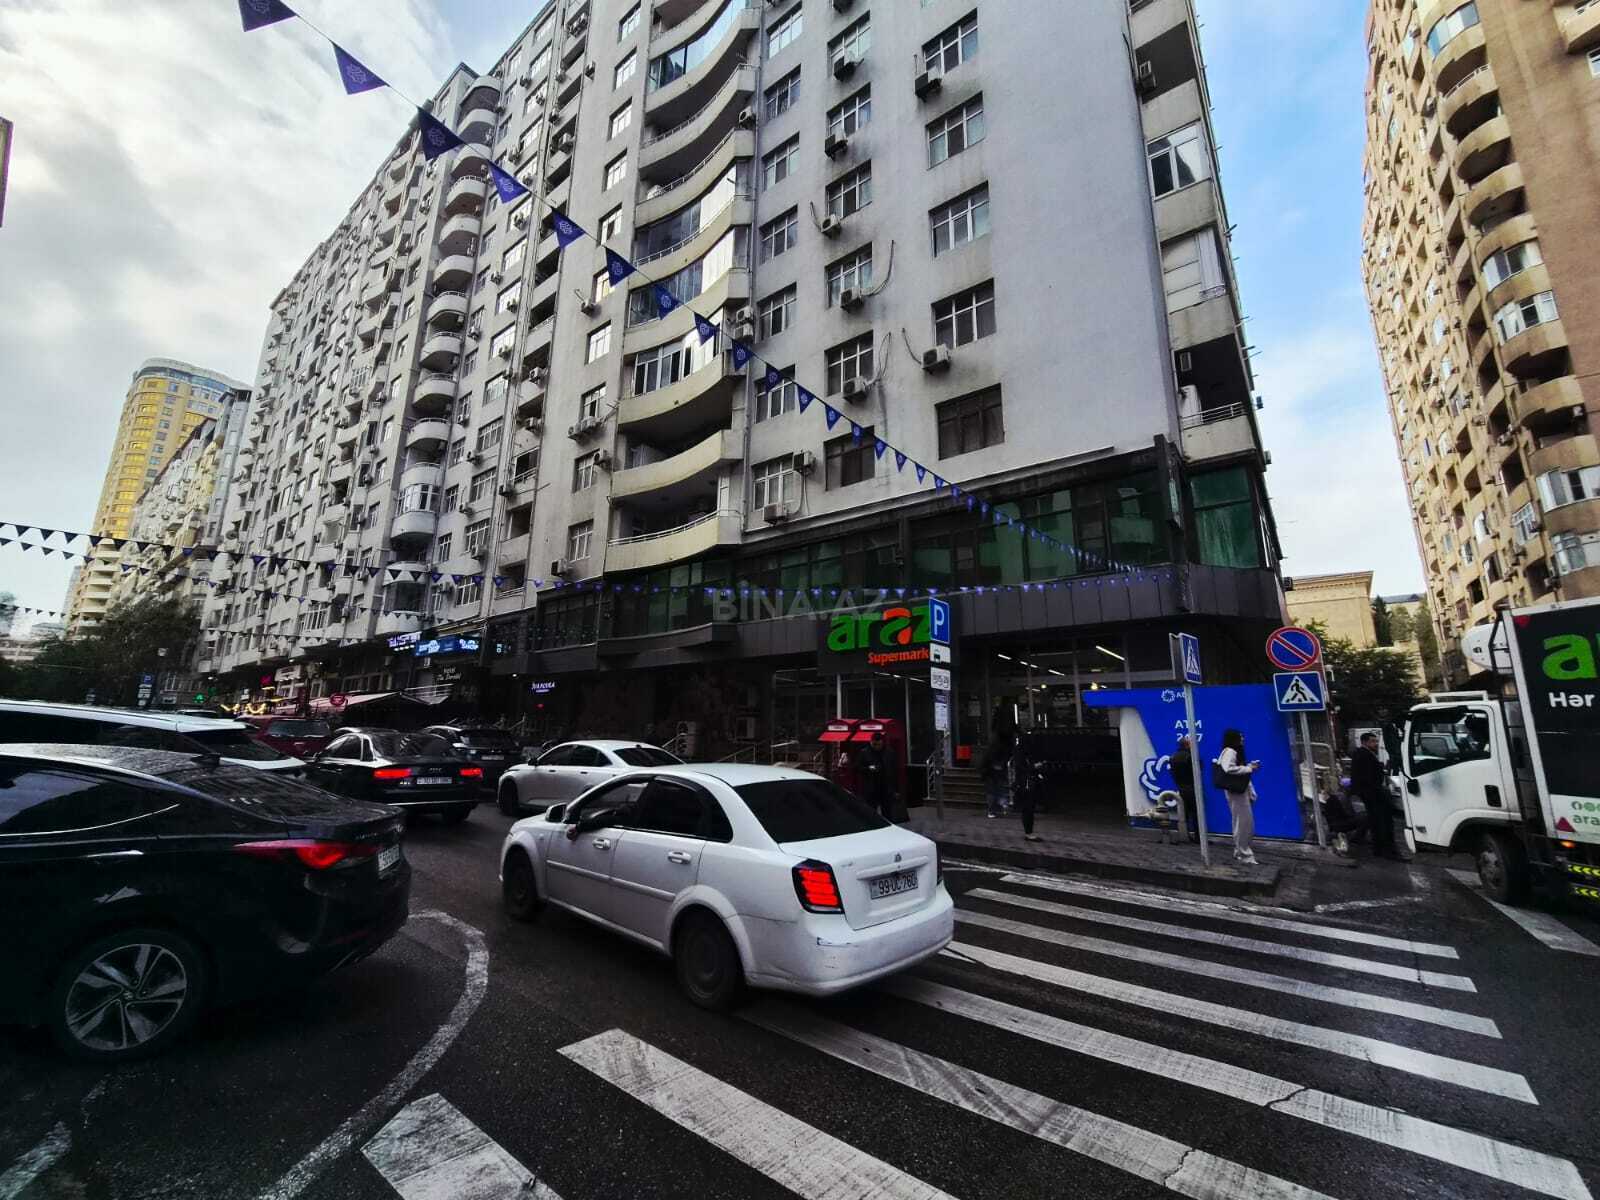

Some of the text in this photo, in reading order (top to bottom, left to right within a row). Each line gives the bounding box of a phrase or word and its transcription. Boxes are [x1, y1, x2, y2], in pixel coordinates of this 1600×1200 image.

[826, 605, 931, 652] araz
[934, 604, 945, 635] P
[867, 647, 930, 666] Supermark
[1542, 633, 1600, 680] a
[1547, 691, 1595, 708] Hər
